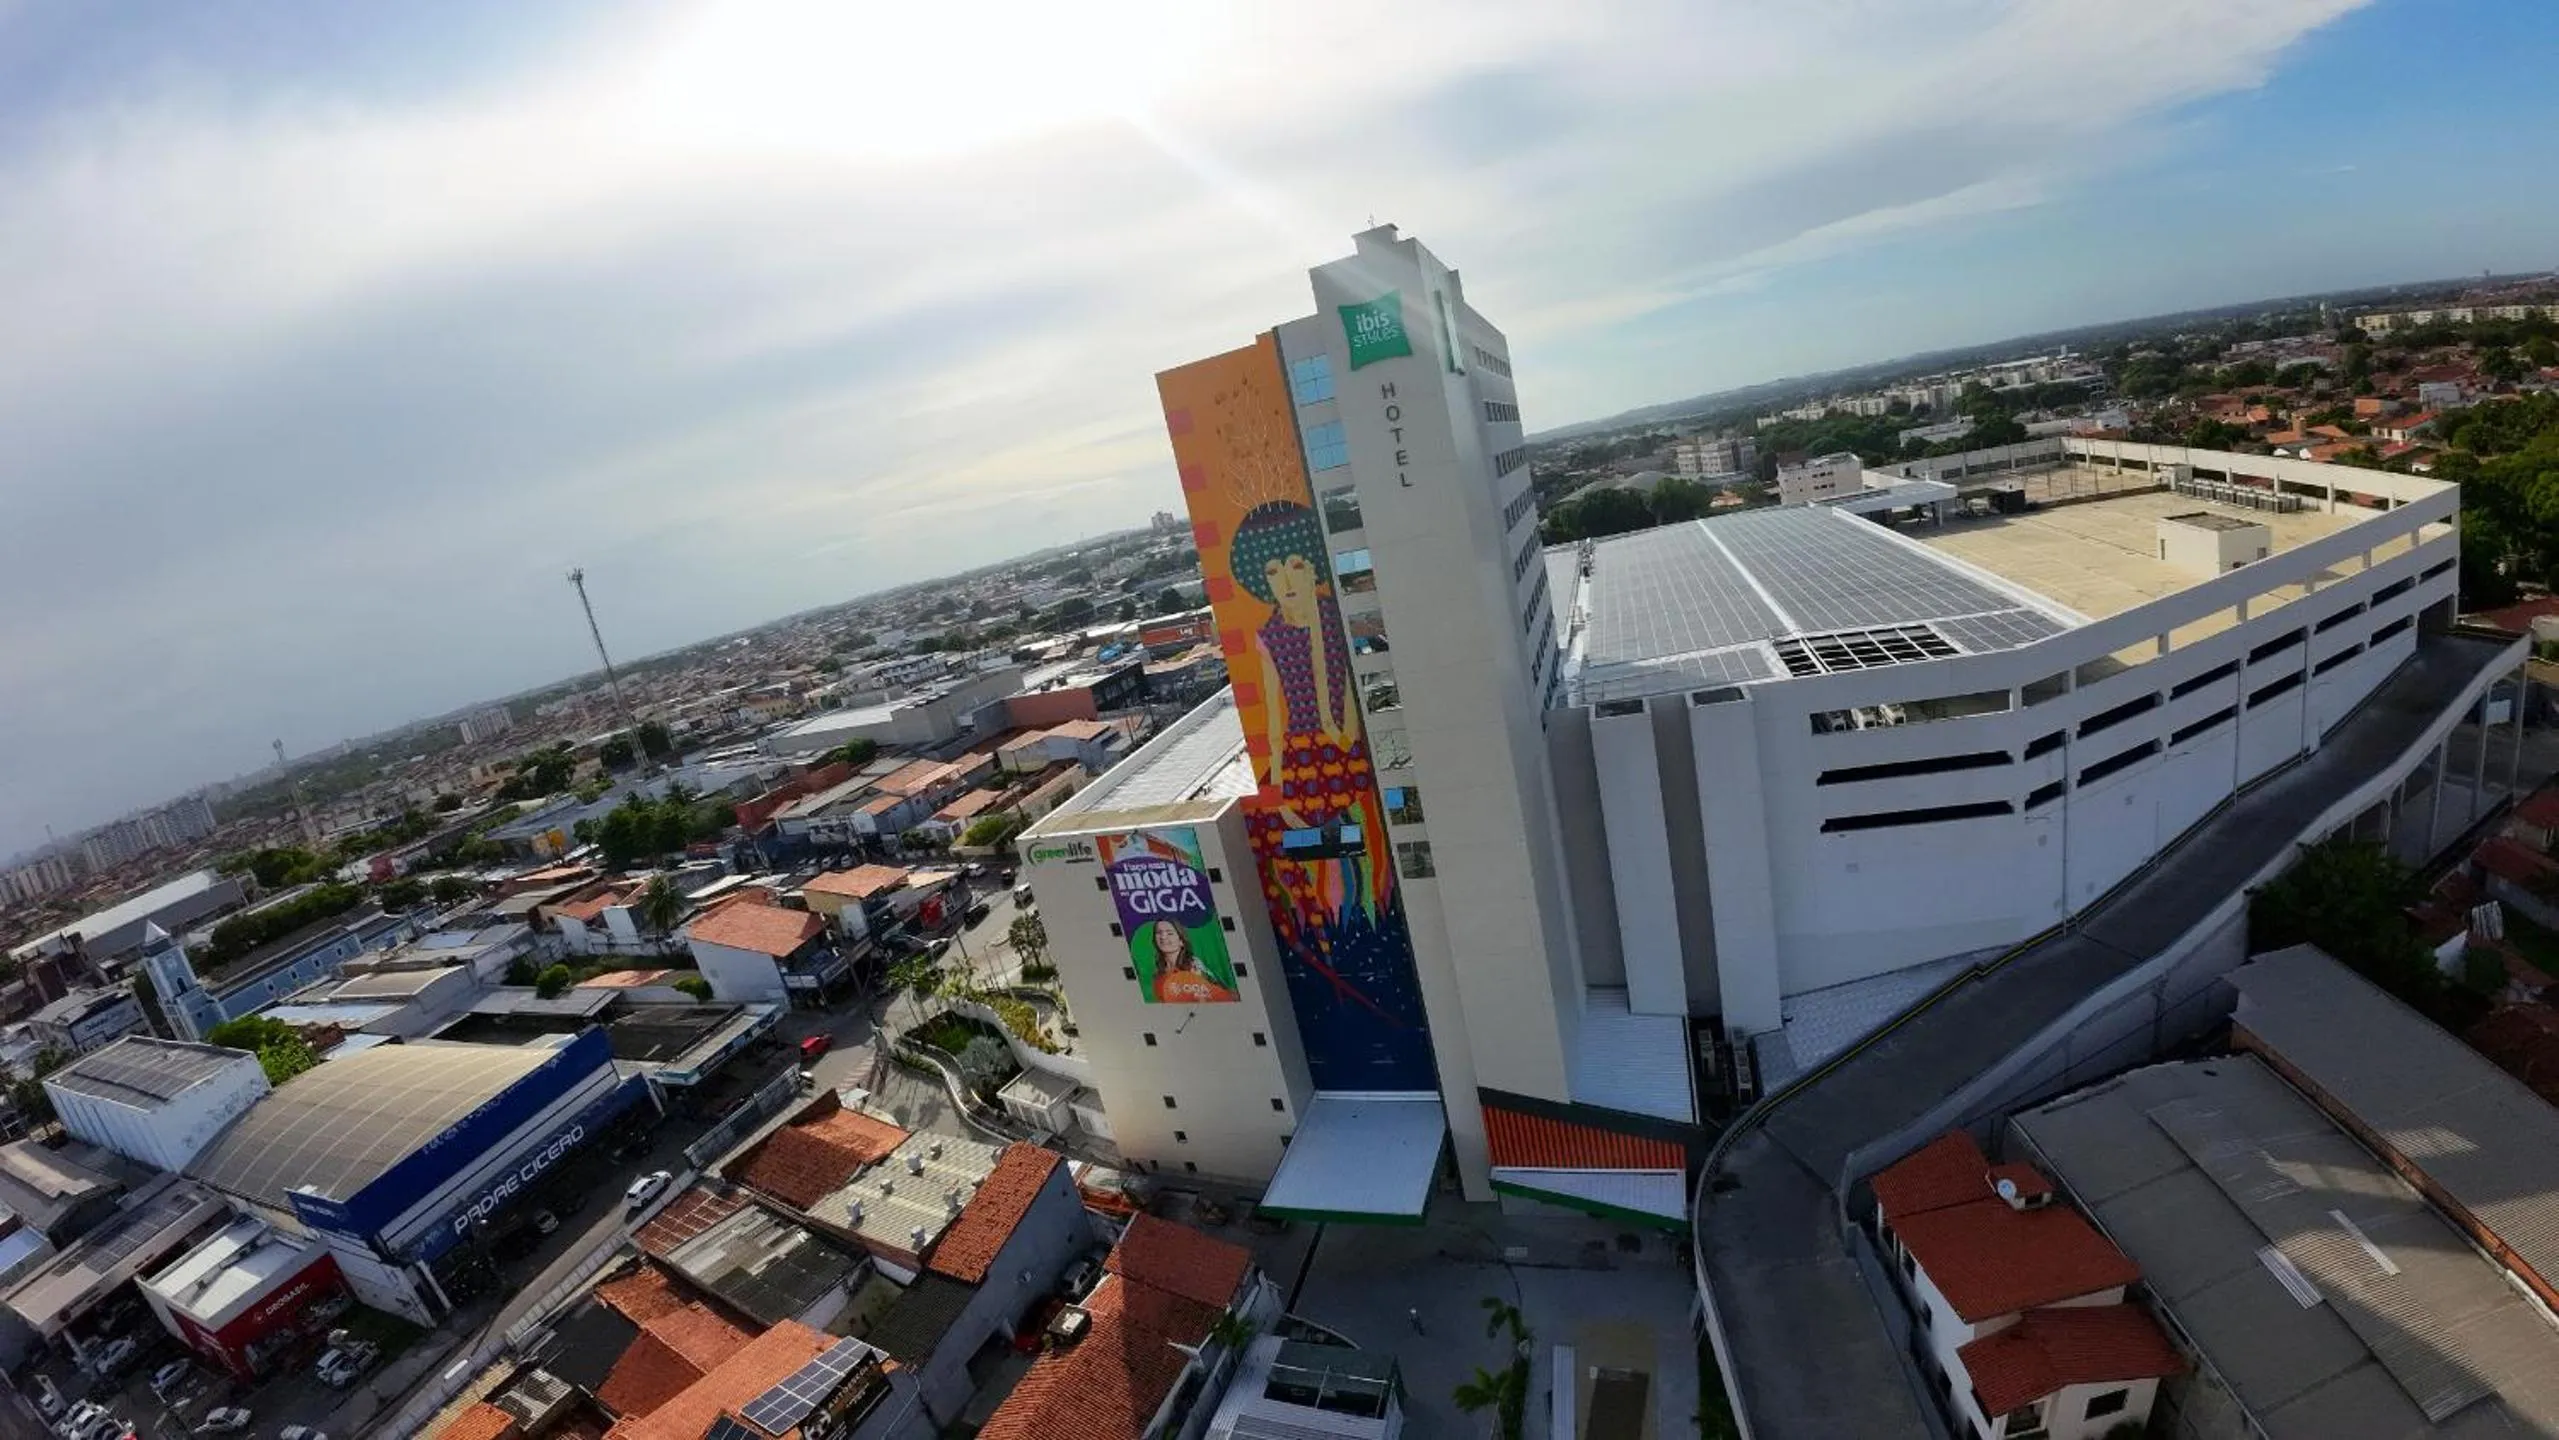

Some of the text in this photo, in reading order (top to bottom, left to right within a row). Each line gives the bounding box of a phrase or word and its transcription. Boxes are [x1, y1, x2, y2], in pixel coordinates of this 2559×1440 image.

[1355, 309, 1390, 333] ibis
[1381, 382, 1415, 488] HOTEL
[1033, 840, 1093, 864] greenlife
[1114, 862, 1199, 890] moda
[1129, 887, 1207, 914] GIGA
[454, 1124, 585, 1235] PADRE CICERO
